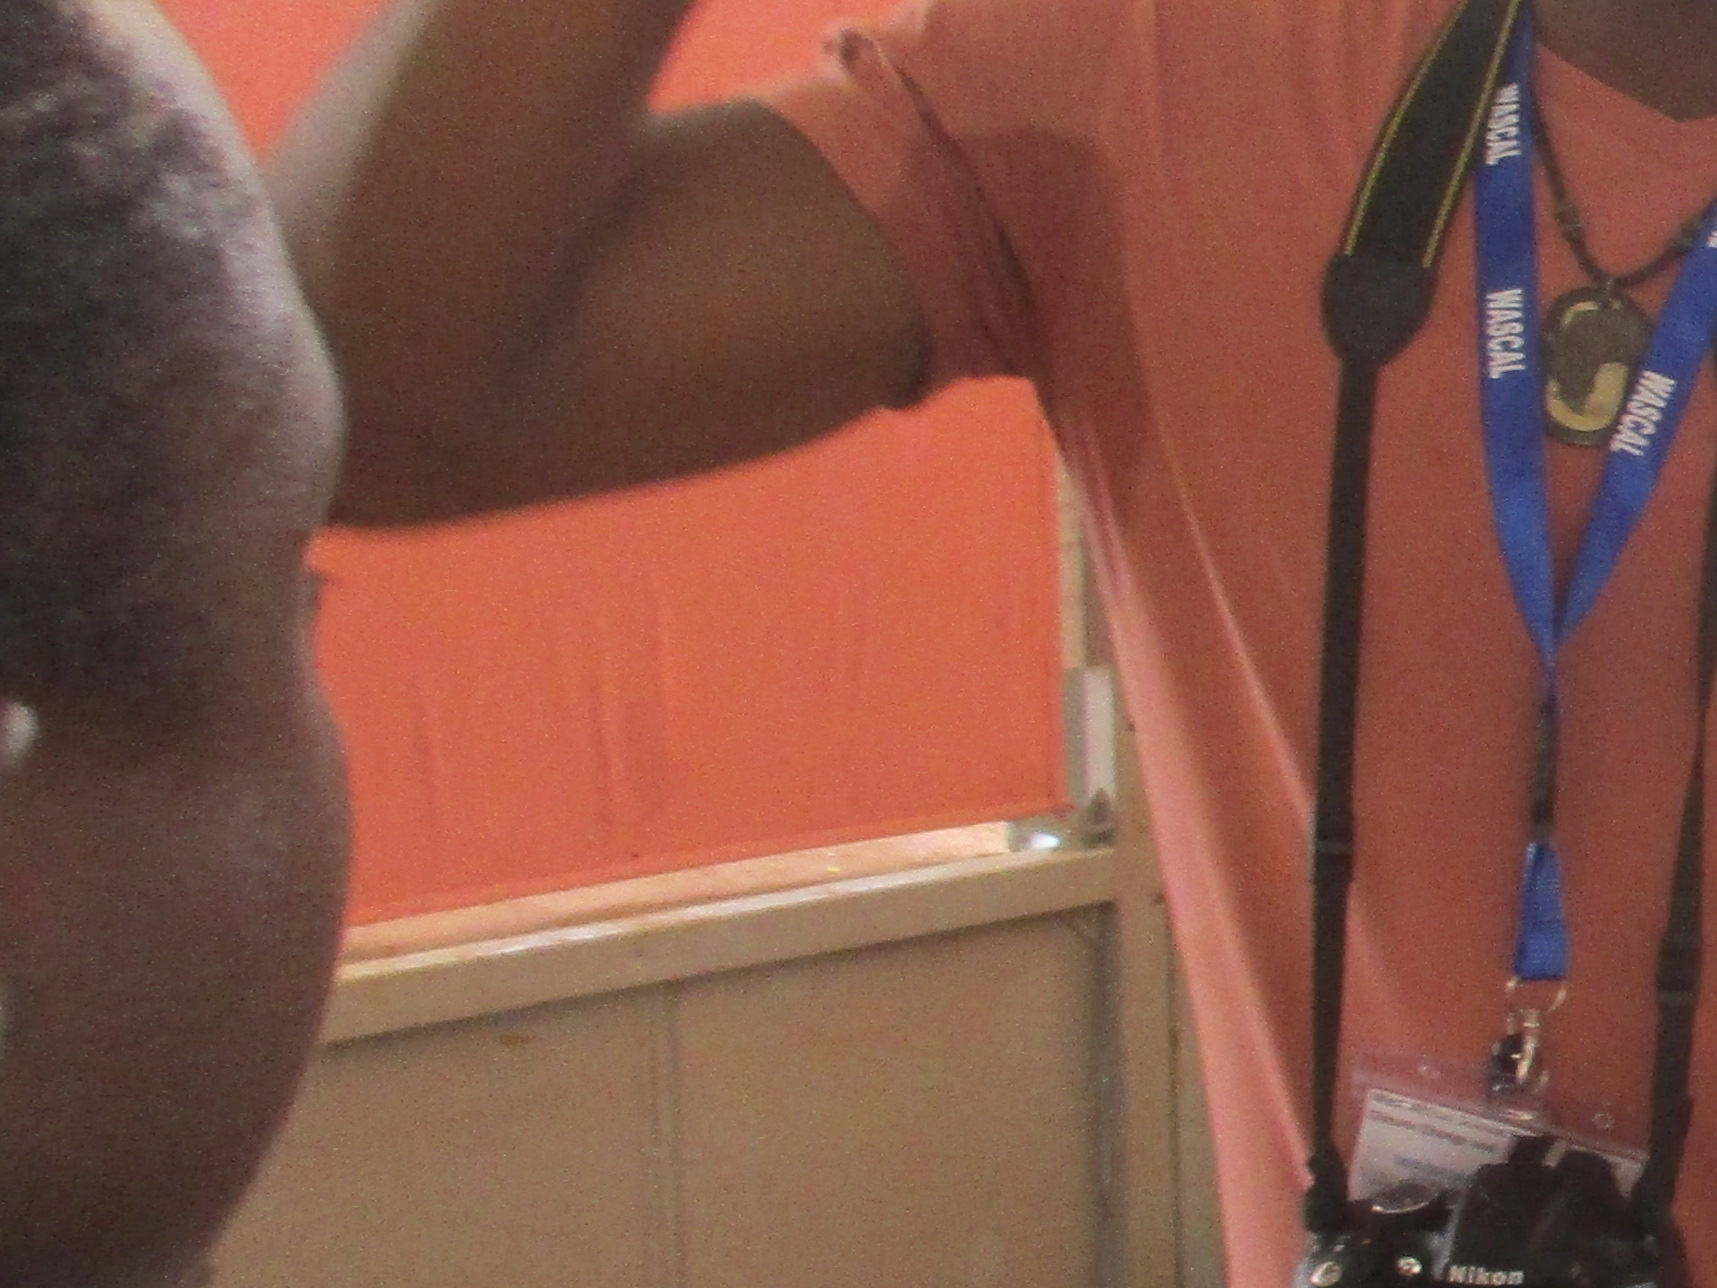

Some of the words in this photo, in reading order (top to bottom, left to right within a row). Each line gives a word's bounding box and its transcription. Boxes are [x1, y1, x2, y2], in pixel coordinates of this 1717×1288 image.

[1484, 82, 1524, 167] WASCAL
[1485, 285, 1529, 381] WASCAL
[1608, 368, 1678, 458] WASCAL
[1447, 1264, 1525, 1287] Nikon
